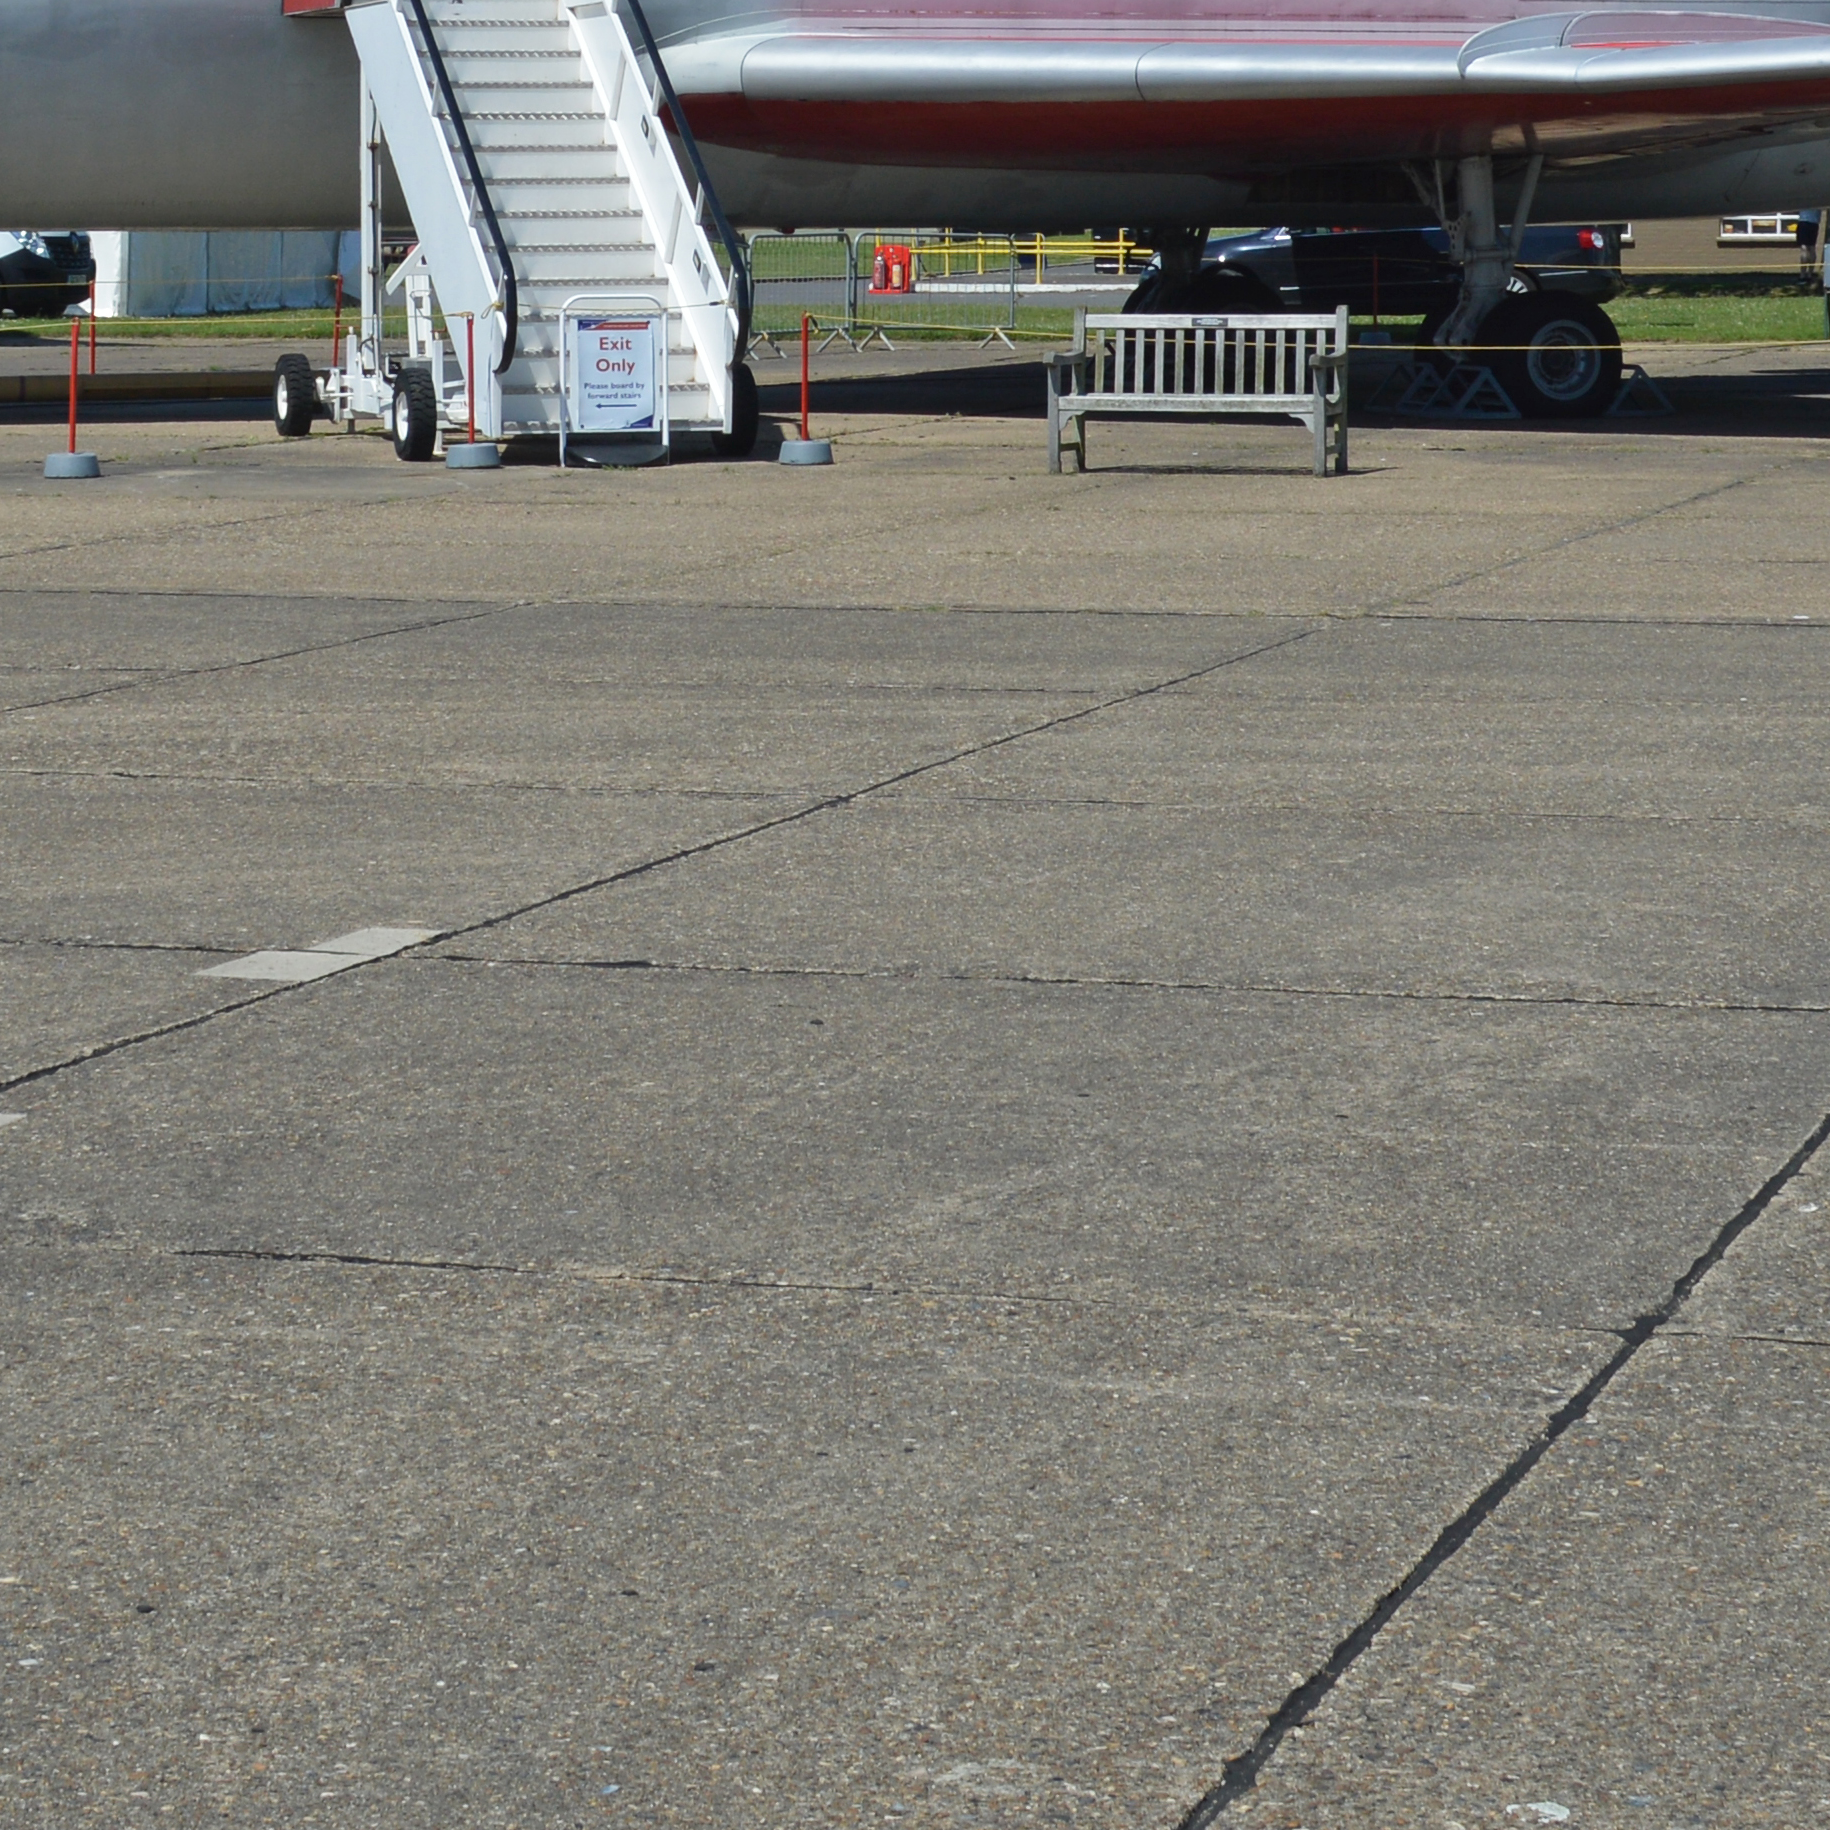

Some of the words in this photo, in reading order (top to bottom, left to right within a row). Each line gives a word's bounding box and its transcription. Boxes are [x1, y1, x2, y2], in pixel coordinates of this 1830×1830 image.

[599, 336, 632, 350] Exit
[596, 358, 635, 376] Only
[636, 382, 645, 391] by
